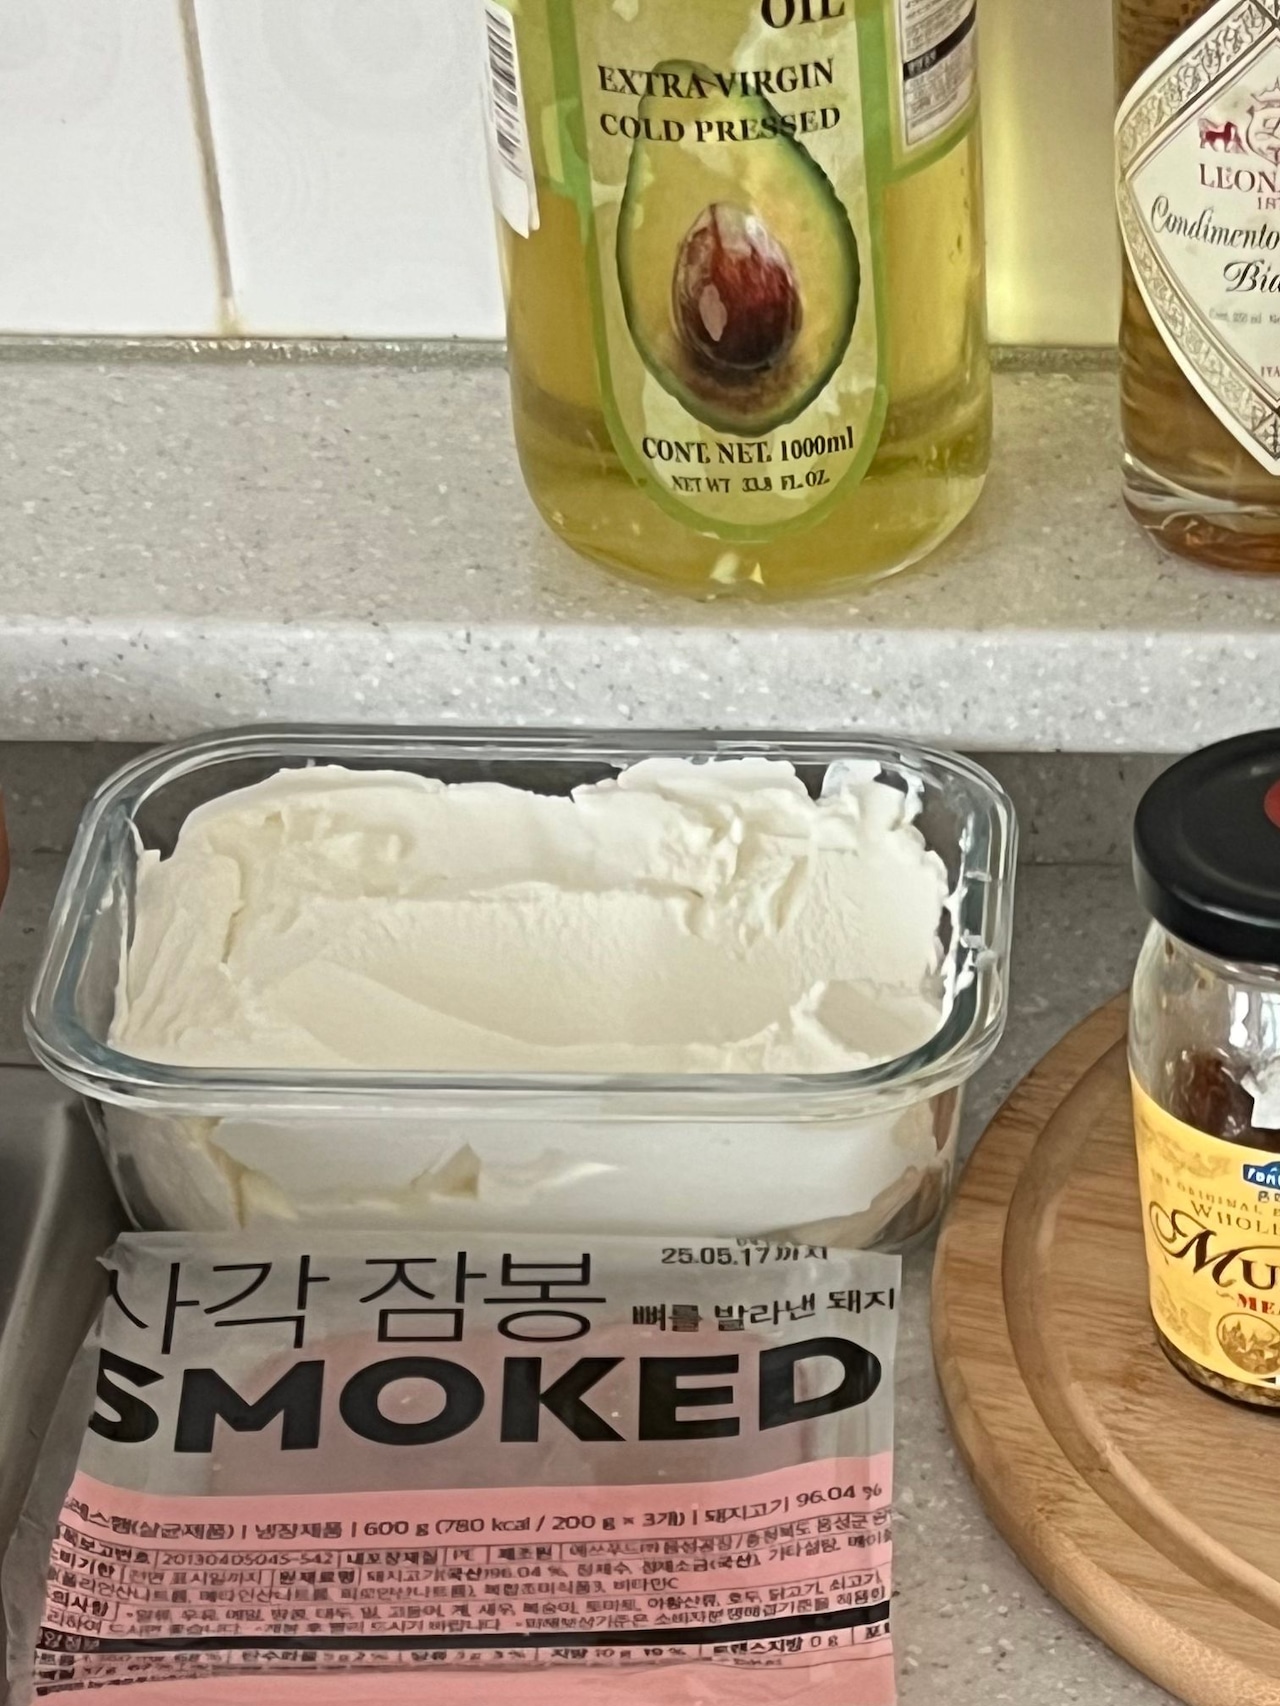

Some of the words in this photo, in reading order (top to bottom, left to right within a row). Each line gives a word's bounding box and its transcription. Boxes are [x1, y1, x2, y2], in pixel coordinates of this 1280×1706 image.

[597, 64, 708, 99] EXTRA
[715, 58, 834, 98] VIRGIN
[600, 113, 685, 142] COLD
[695, 107, 840, 142] PRESSED
[1150, 194, 1280, 250] Condimento
[781, 426, 853, 461] 1000ml
[672, 475, 702, 493] NET
[706, 477, 730, 493] WT
[110, 1255, 330, 1354] 사각
[359, 1251, 606, 1342] 잠봉
[632, 1304, 703, 1332] 뼈를
[714, 1292, 816, 1332] 발라낸
[826, 1288, 895, 1315] 돼지
[88, 1337, 882, 1453] SMOKED
[364, 1520, 409, 1537] 600
[435, 1519, 485, 1536] (780
[491, 1516, 531, 1532] kcal
[552, 1515, 596, 1531] 200
[705, 1496, 790, 1523] 돼지고기
[795, 1485, 856, 1507] 96.04
[613, 1576, 680, 1592] 비타민C
